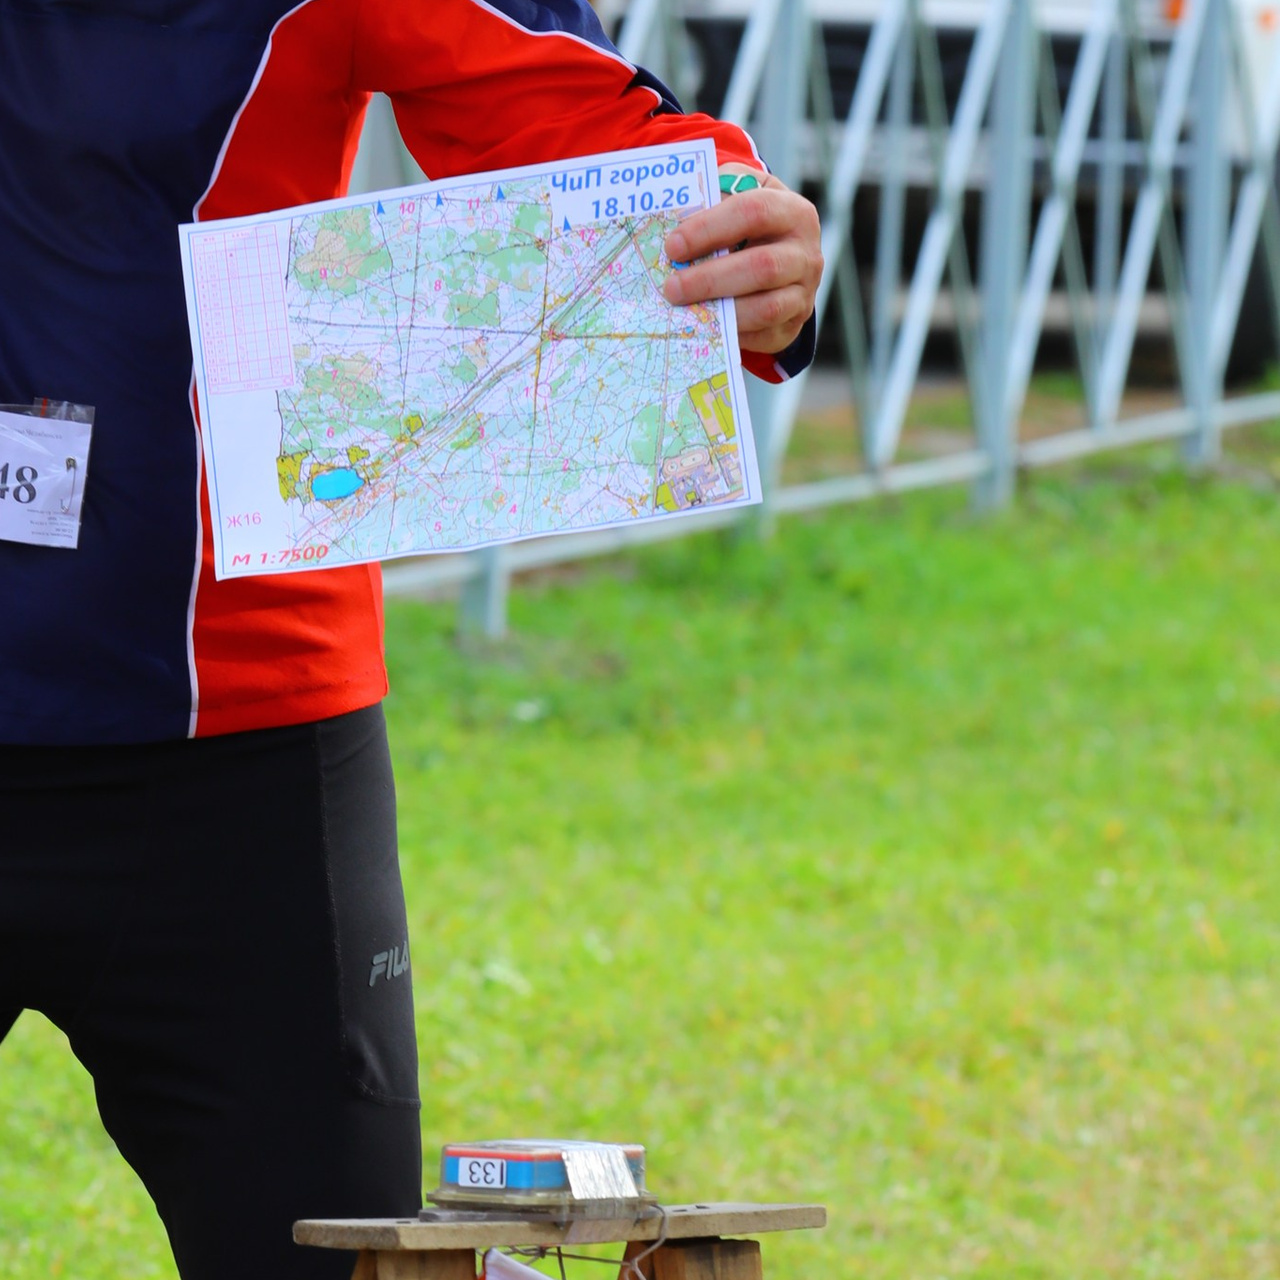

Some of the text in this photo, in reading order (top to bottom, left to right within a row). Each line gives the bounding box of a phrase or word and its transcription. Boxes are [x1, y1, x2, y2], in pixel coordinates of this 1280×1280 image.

[551, 154, 696, 193] ЧиП города
[400, 202, 415, 215] 10
[467, 197, 480, 210] 11
[592, 186, 690, 219] 18.10.26
[580, 229, 595, 241] 12
[319, 267, 327, 279] 9
[608, 263, 622, 275] 13
[434, 280, 442, 292] 8
[332, 369, 338, 381] 7
[524, 386, 530, 398] 1
[326, 426, 335, 438] 6
[478, 426, 485, 439] 3
[562, 458, 569, 471] 2
[509, 504, 517, 514] 4
[227, 512, 262, 529] Ж16
[434, 521, 442, 532] 5
[260, 545, 329, 565] 1:7500
[468, 1160, 505, 1186] 133
